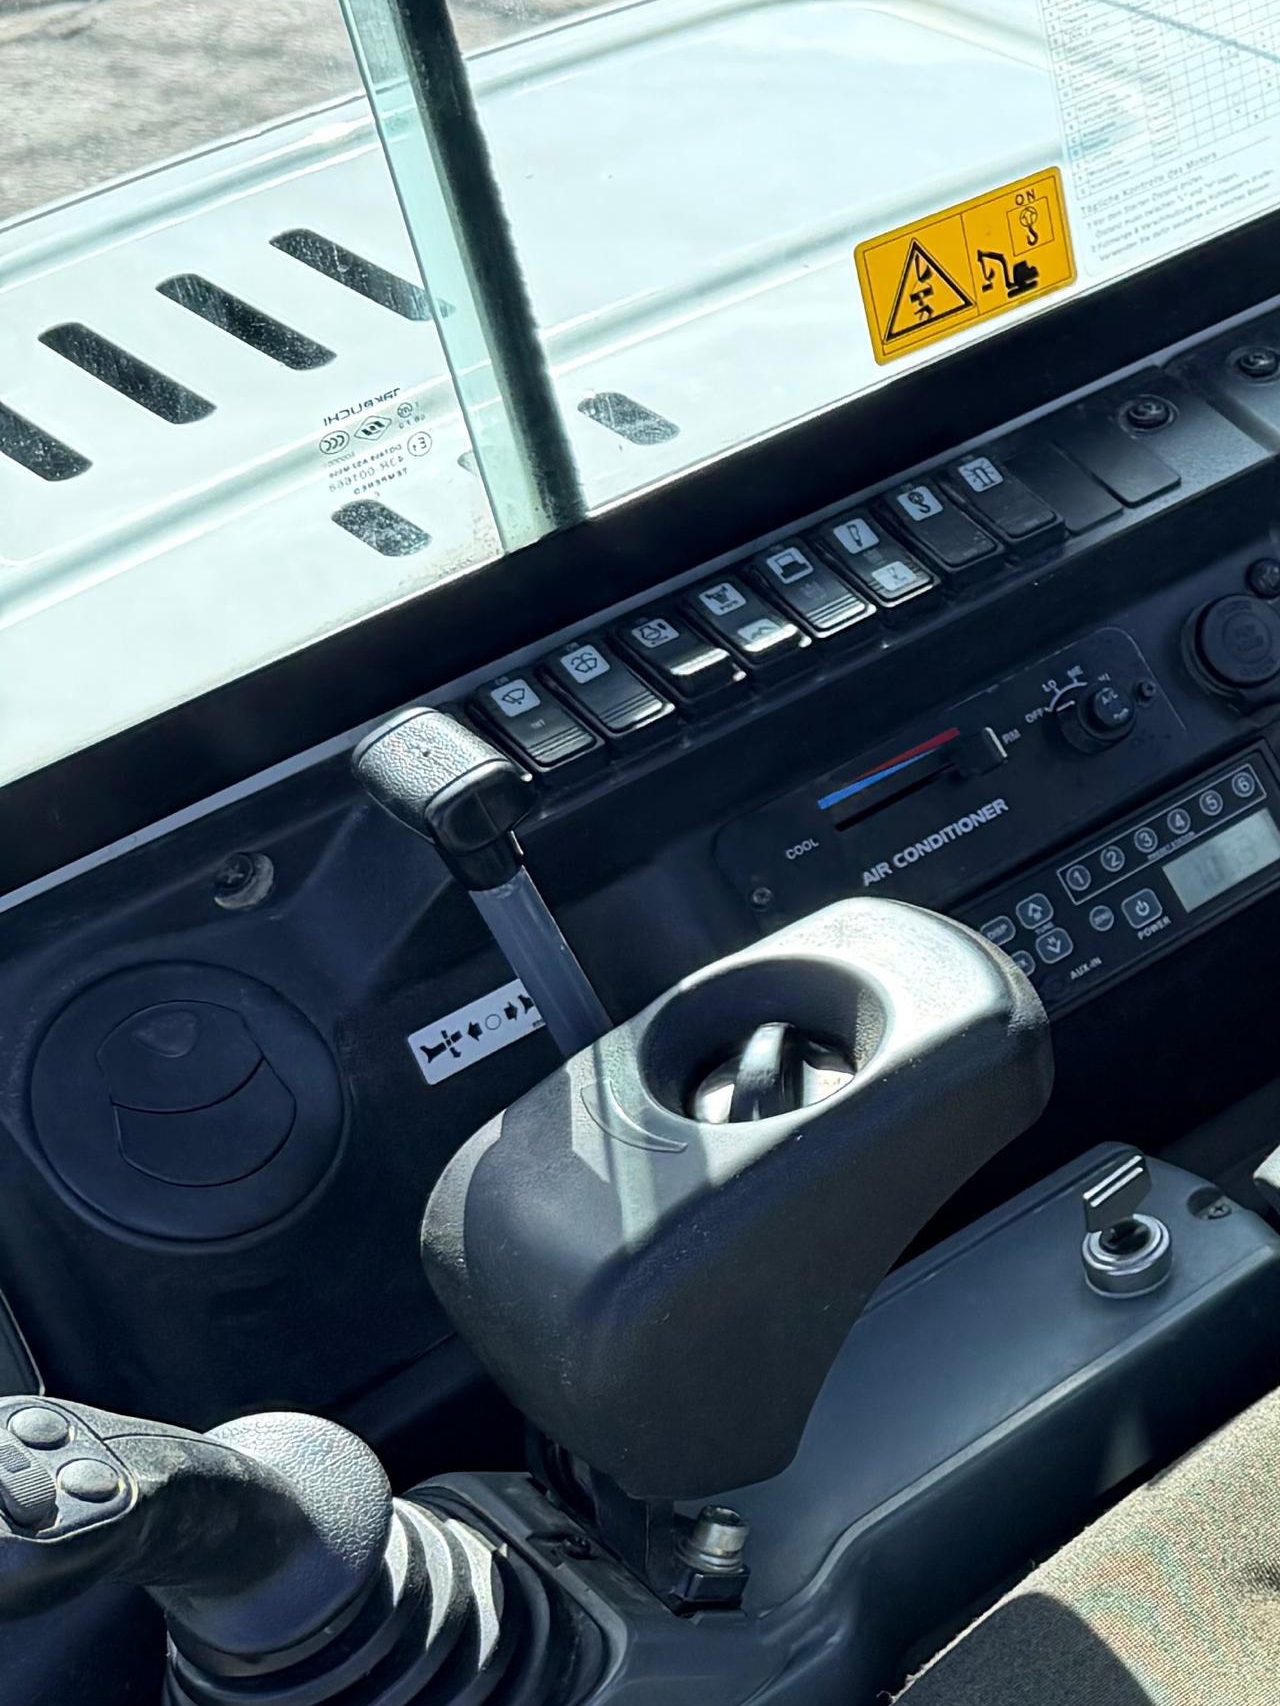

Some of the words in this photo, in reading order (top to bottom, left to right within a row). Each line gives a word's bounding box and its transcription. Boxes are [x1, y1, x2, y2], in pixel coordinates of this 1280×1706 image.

[1015, 189, 1035, 206] ON
[1024, 706, 1044, 724] OFF
[1002, 729, 1021, 745] RM
[785, 837, 819, 861] COOL
[861, 861, 893, 888] AIR
[893, 798, 1009, 869] CONDITIONER
[1137, 915, 1172, 940] POWER
[1069, 957, 1103, 980] AUX-IN
